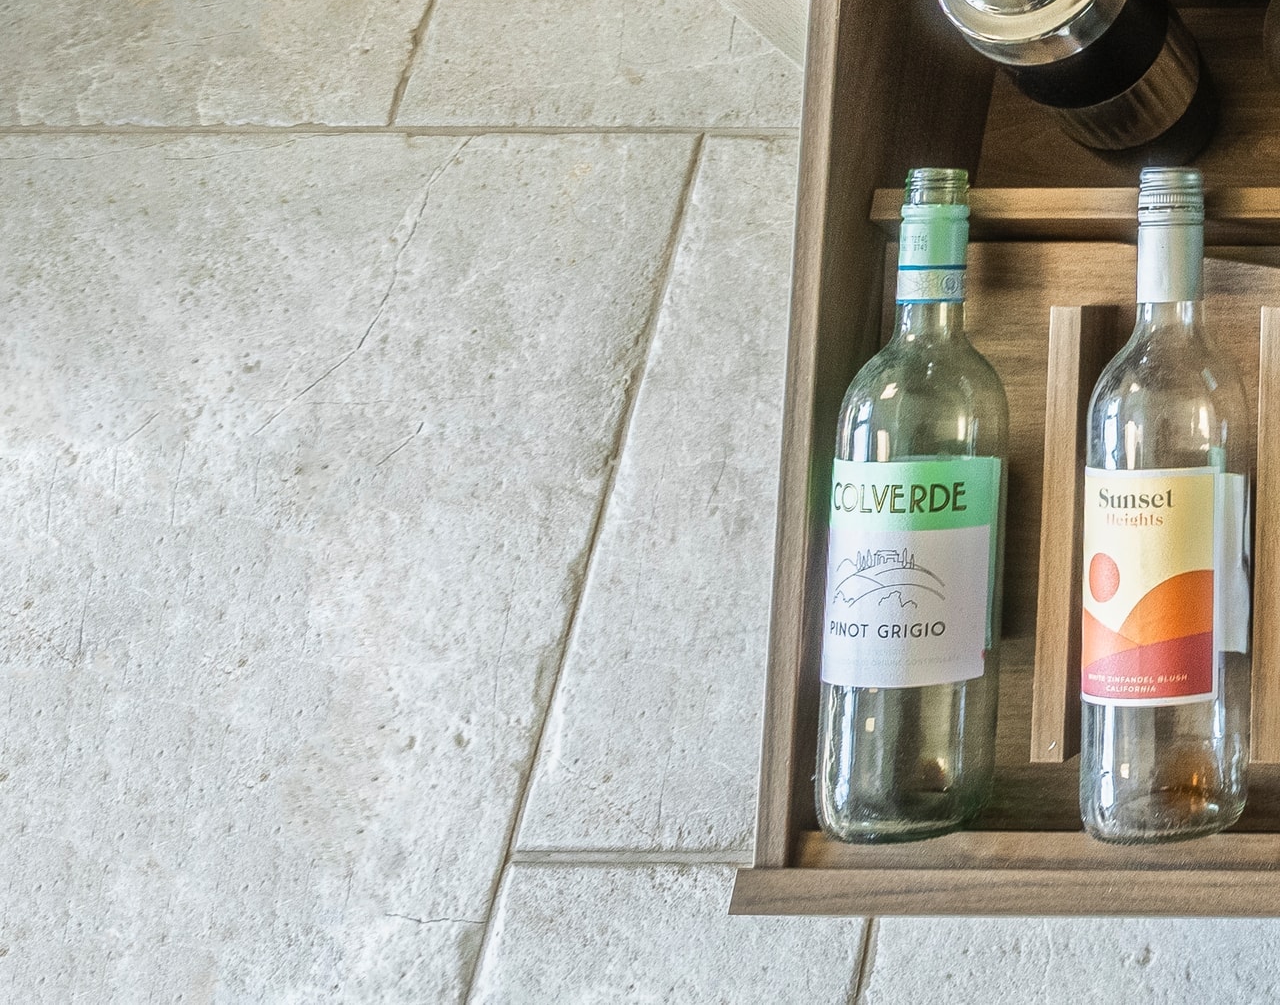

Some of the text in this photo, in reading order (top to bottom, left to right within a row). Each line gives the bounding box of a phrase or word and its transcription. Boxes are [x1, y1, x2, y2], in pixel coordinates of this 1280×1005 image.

[833, 481, 968, 514] COLVERDE
[1098, 487, 1175, 509] Sunset
[1106, 512, 1164, 528] Heights
[830, 620, 946, 639] PINOT GRIGIO
[1106, 674, 1154, 683] ZINFANDEL
[1157, 673, 1188, 683] BLUSH
[1105, 685, 1157, 693] CALIFORNIA
